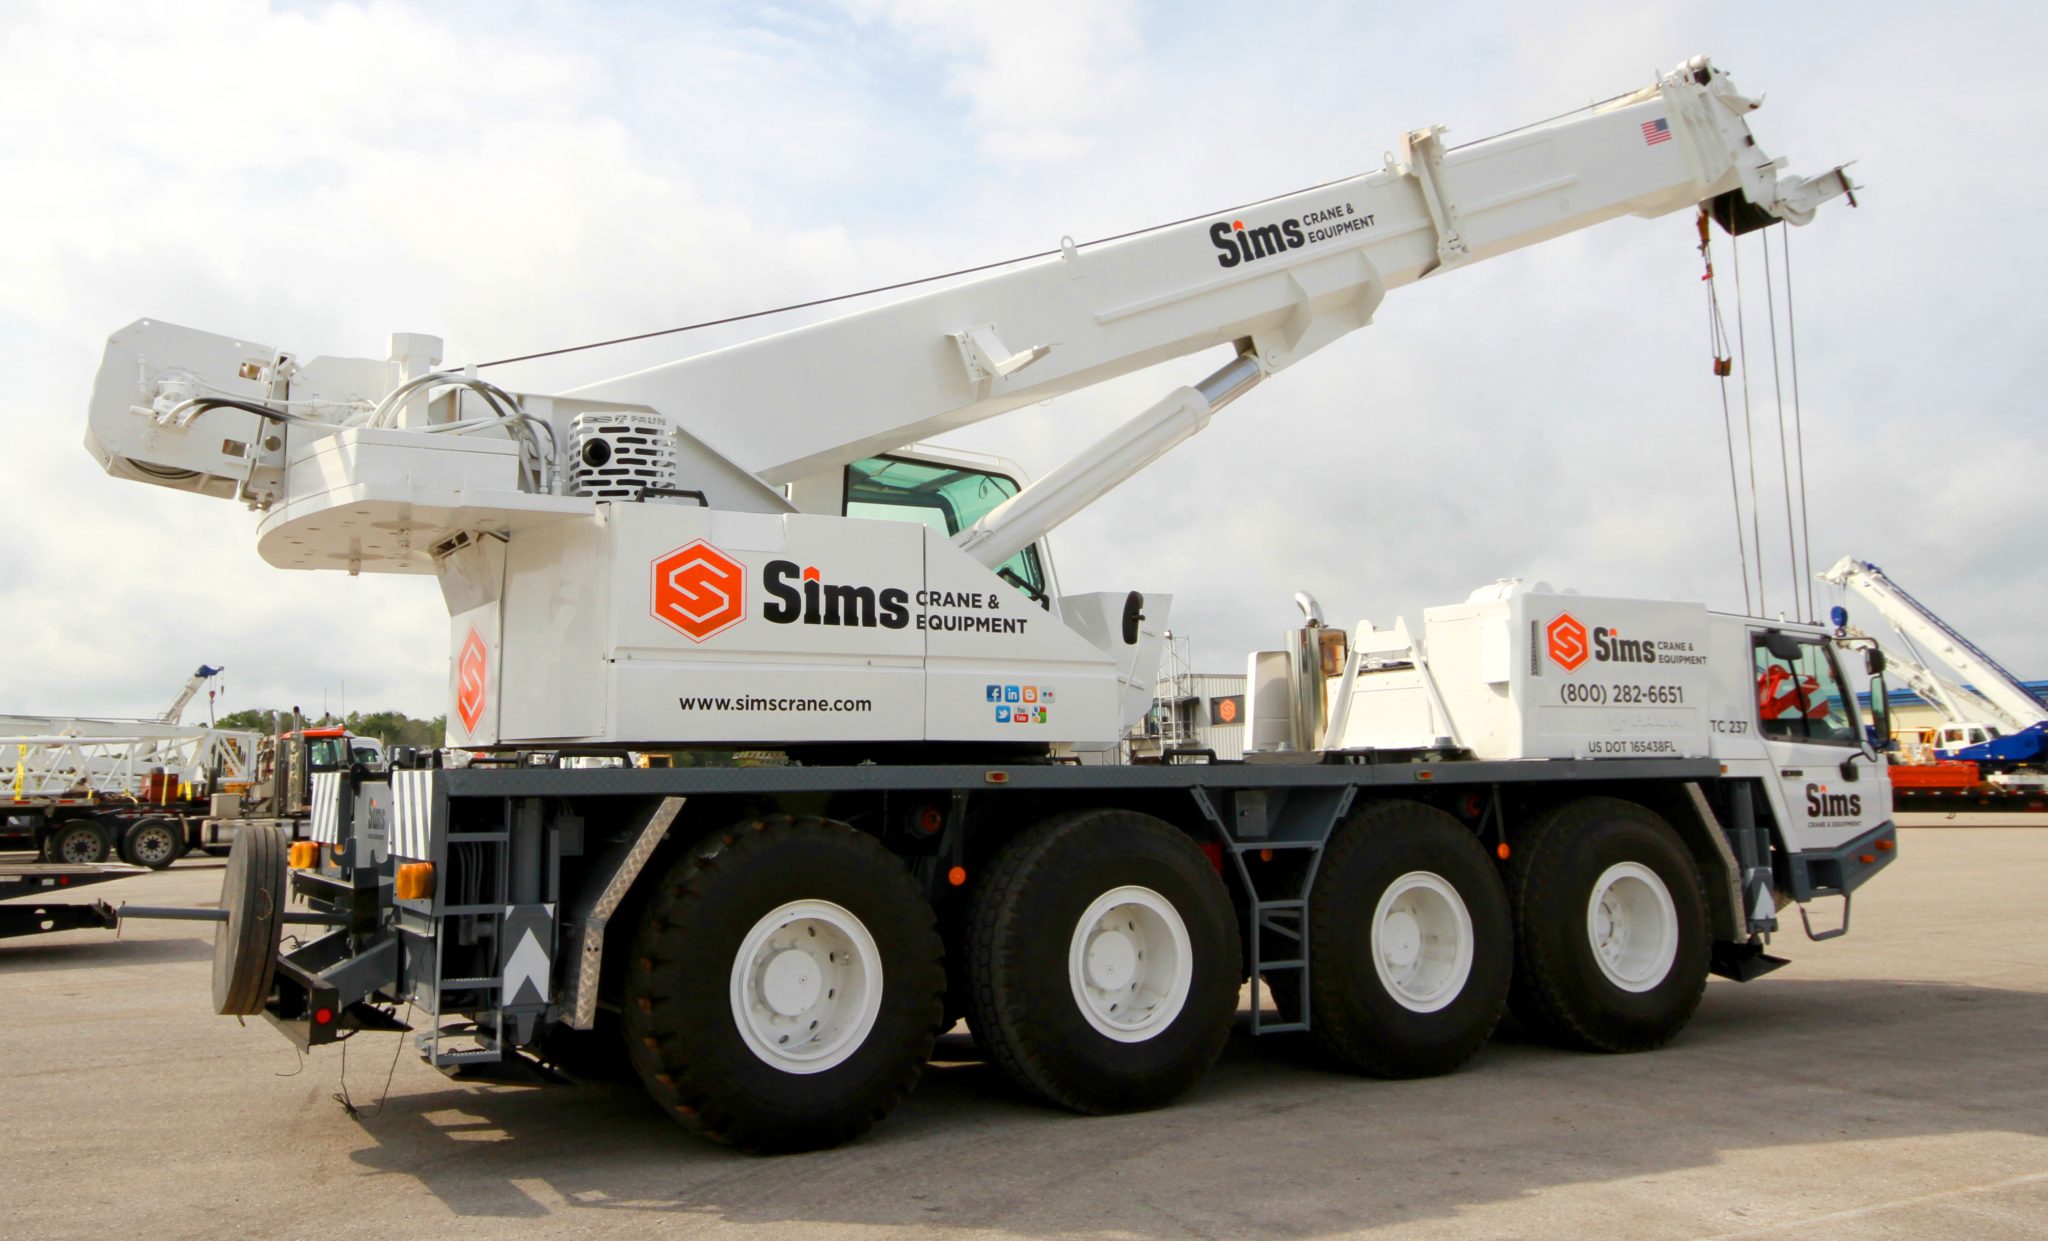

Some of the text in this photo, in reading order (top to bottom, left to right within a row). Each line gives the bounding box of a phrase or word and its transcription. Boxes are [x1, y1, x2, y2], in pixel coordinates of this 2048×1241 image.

[1302, 202, 1354, 226] CRANE &
[1308, 214, 1376, 244] EQUIPMENT
[1209, 219, 1305, 268] Sims
[763, 560, 909, 630] Sims
[916, 591, 1000, 610] CRANE &
[916, 614, 1028, 634] EQUIPMENT
[1593, 626, 1656, 664] Sims
[1657, 641, 1694, 652] CRANE &
[1659, 654, 1707, 665] EQUIPMENT
[679, 695, 872, 712] www.simscrane.com
[1560, 683, 1684, 705] (800) 282-6651
[1710, 720, 1748, 734] TC 237
[1588, 741, 1676, 753] US DOT 165438FL
[1806, 783, 1861, 817] Sims
